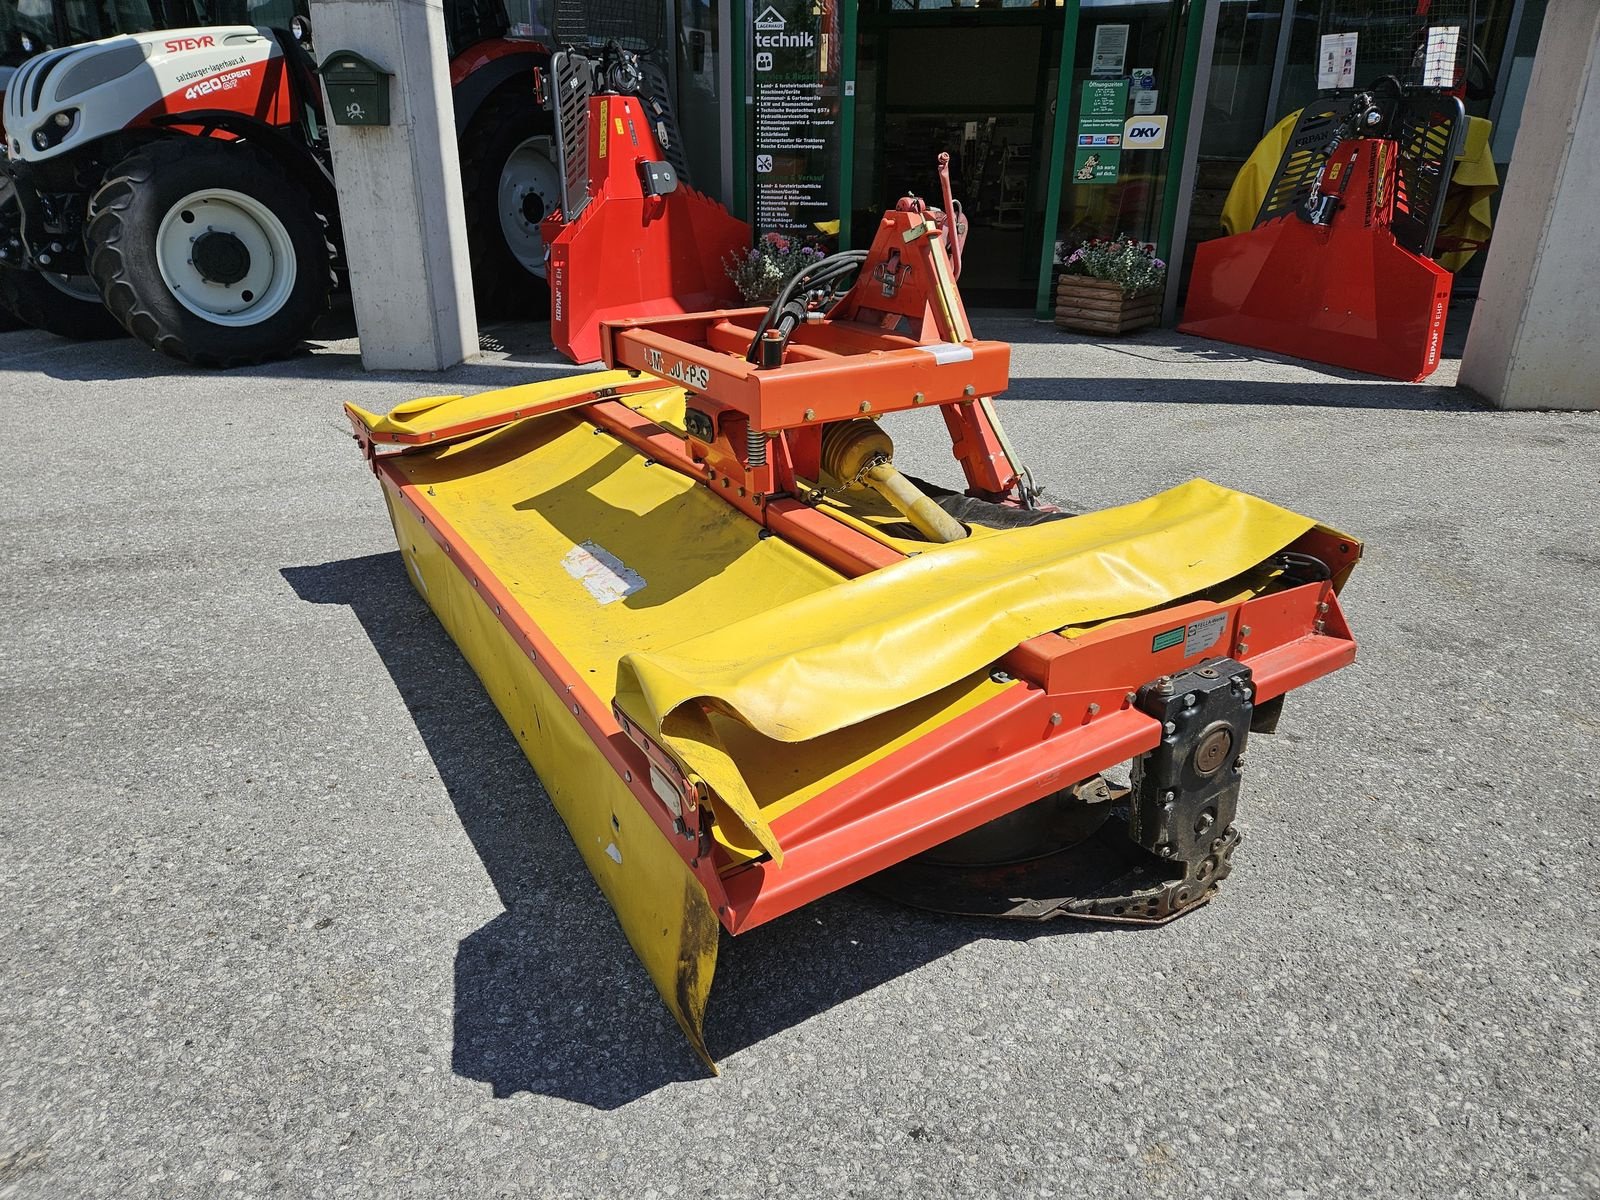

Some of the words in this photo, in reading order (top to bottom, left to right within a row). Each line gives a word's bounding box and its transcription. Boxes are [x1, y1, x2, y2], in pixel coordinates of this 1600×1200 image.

[165, 36, 215, 53] STEYR
[755, 32, 813, 47] technik
[176, 56, 246, 82] salzburger-lagerhaus.at
[185, 78, 222, 100] 4120
[220, 69, 251, 82] EXPERT
[222, 80, 237, 90] CVT
[1129, 128, 1160, 137] DKV
[1198, 616, 1225, 627] FELLA-Werke
